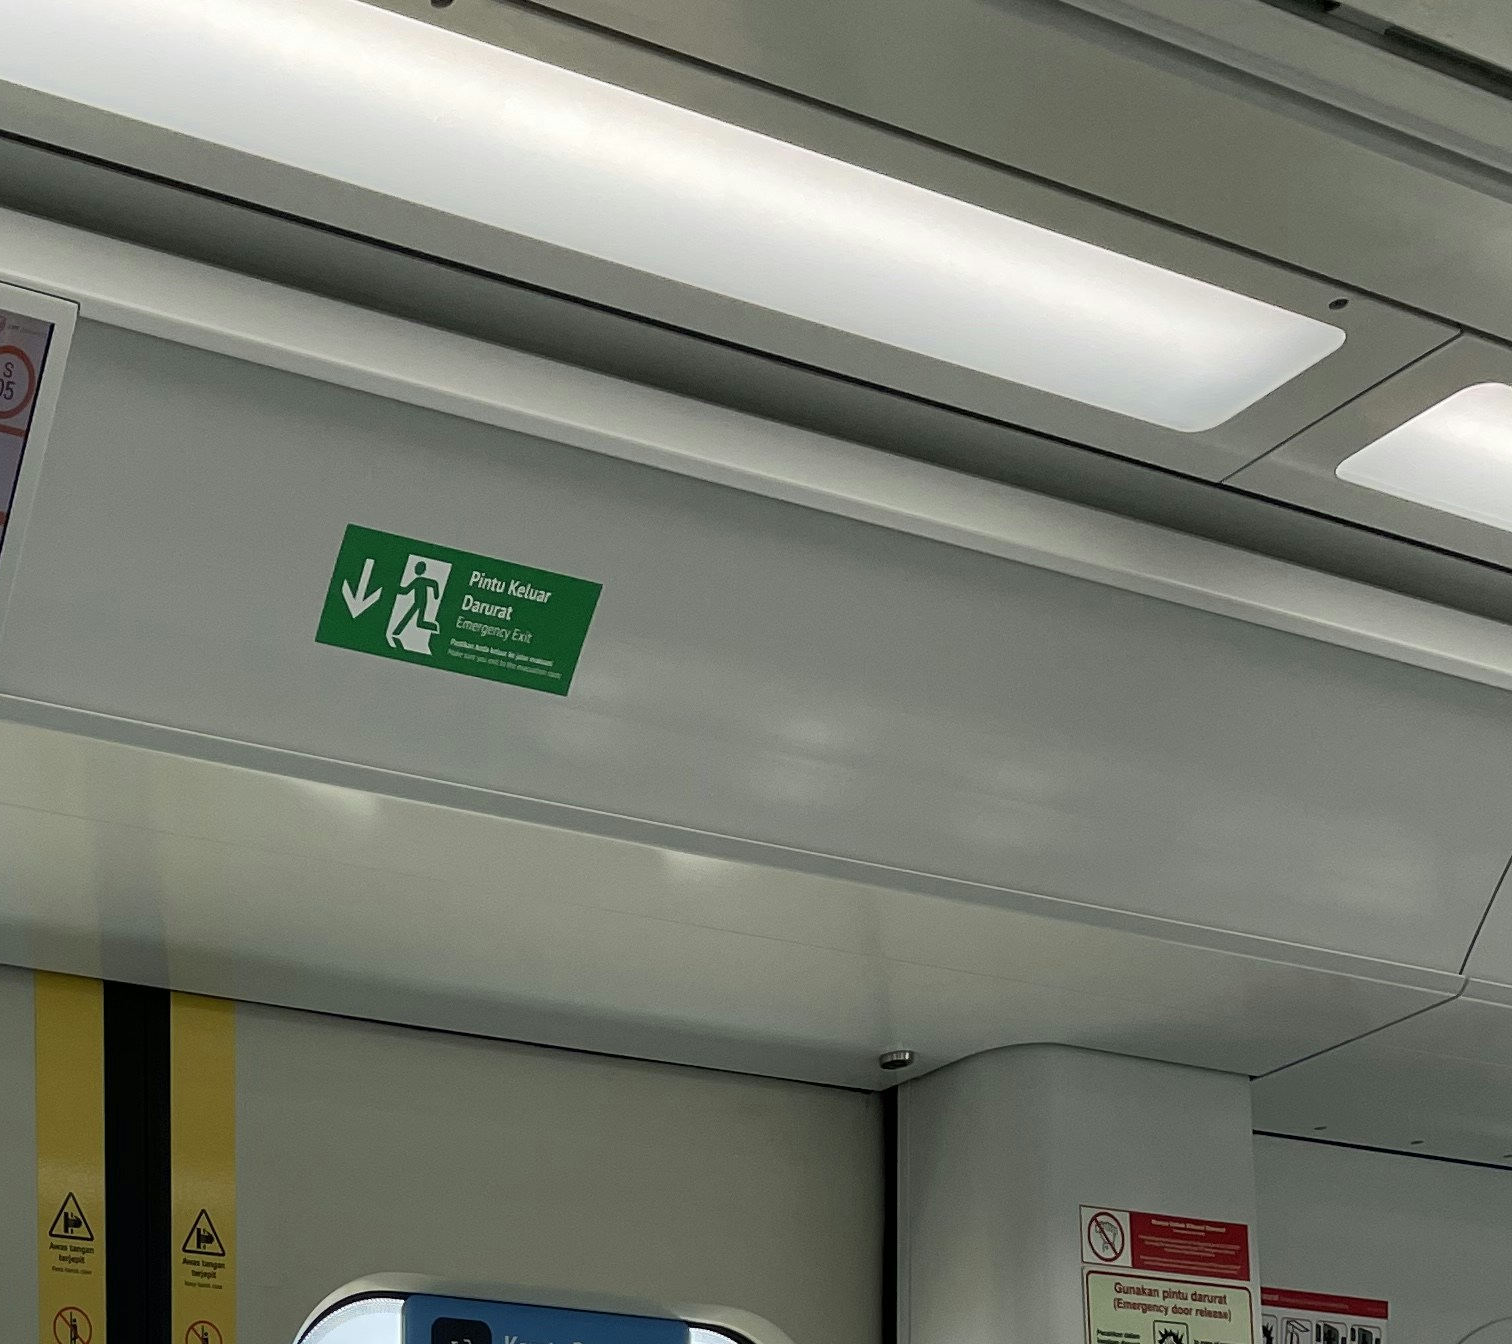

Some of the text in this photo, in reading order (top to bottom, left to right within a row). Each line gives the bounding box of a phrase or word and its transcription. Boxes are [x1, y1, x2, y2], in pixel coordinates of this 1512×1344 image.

[2, 362, 14, 378] S
[468, 570, 552, 604] Pintu Keluar
[461, 594, 514, 621] Darurat
[456, 616, 534, 644] Emergency Exit
[1114, 1282, 1228, 1305] Gunakan pintu darurat
[1113, 1297, 1232, 1323] (Emergency door release)
